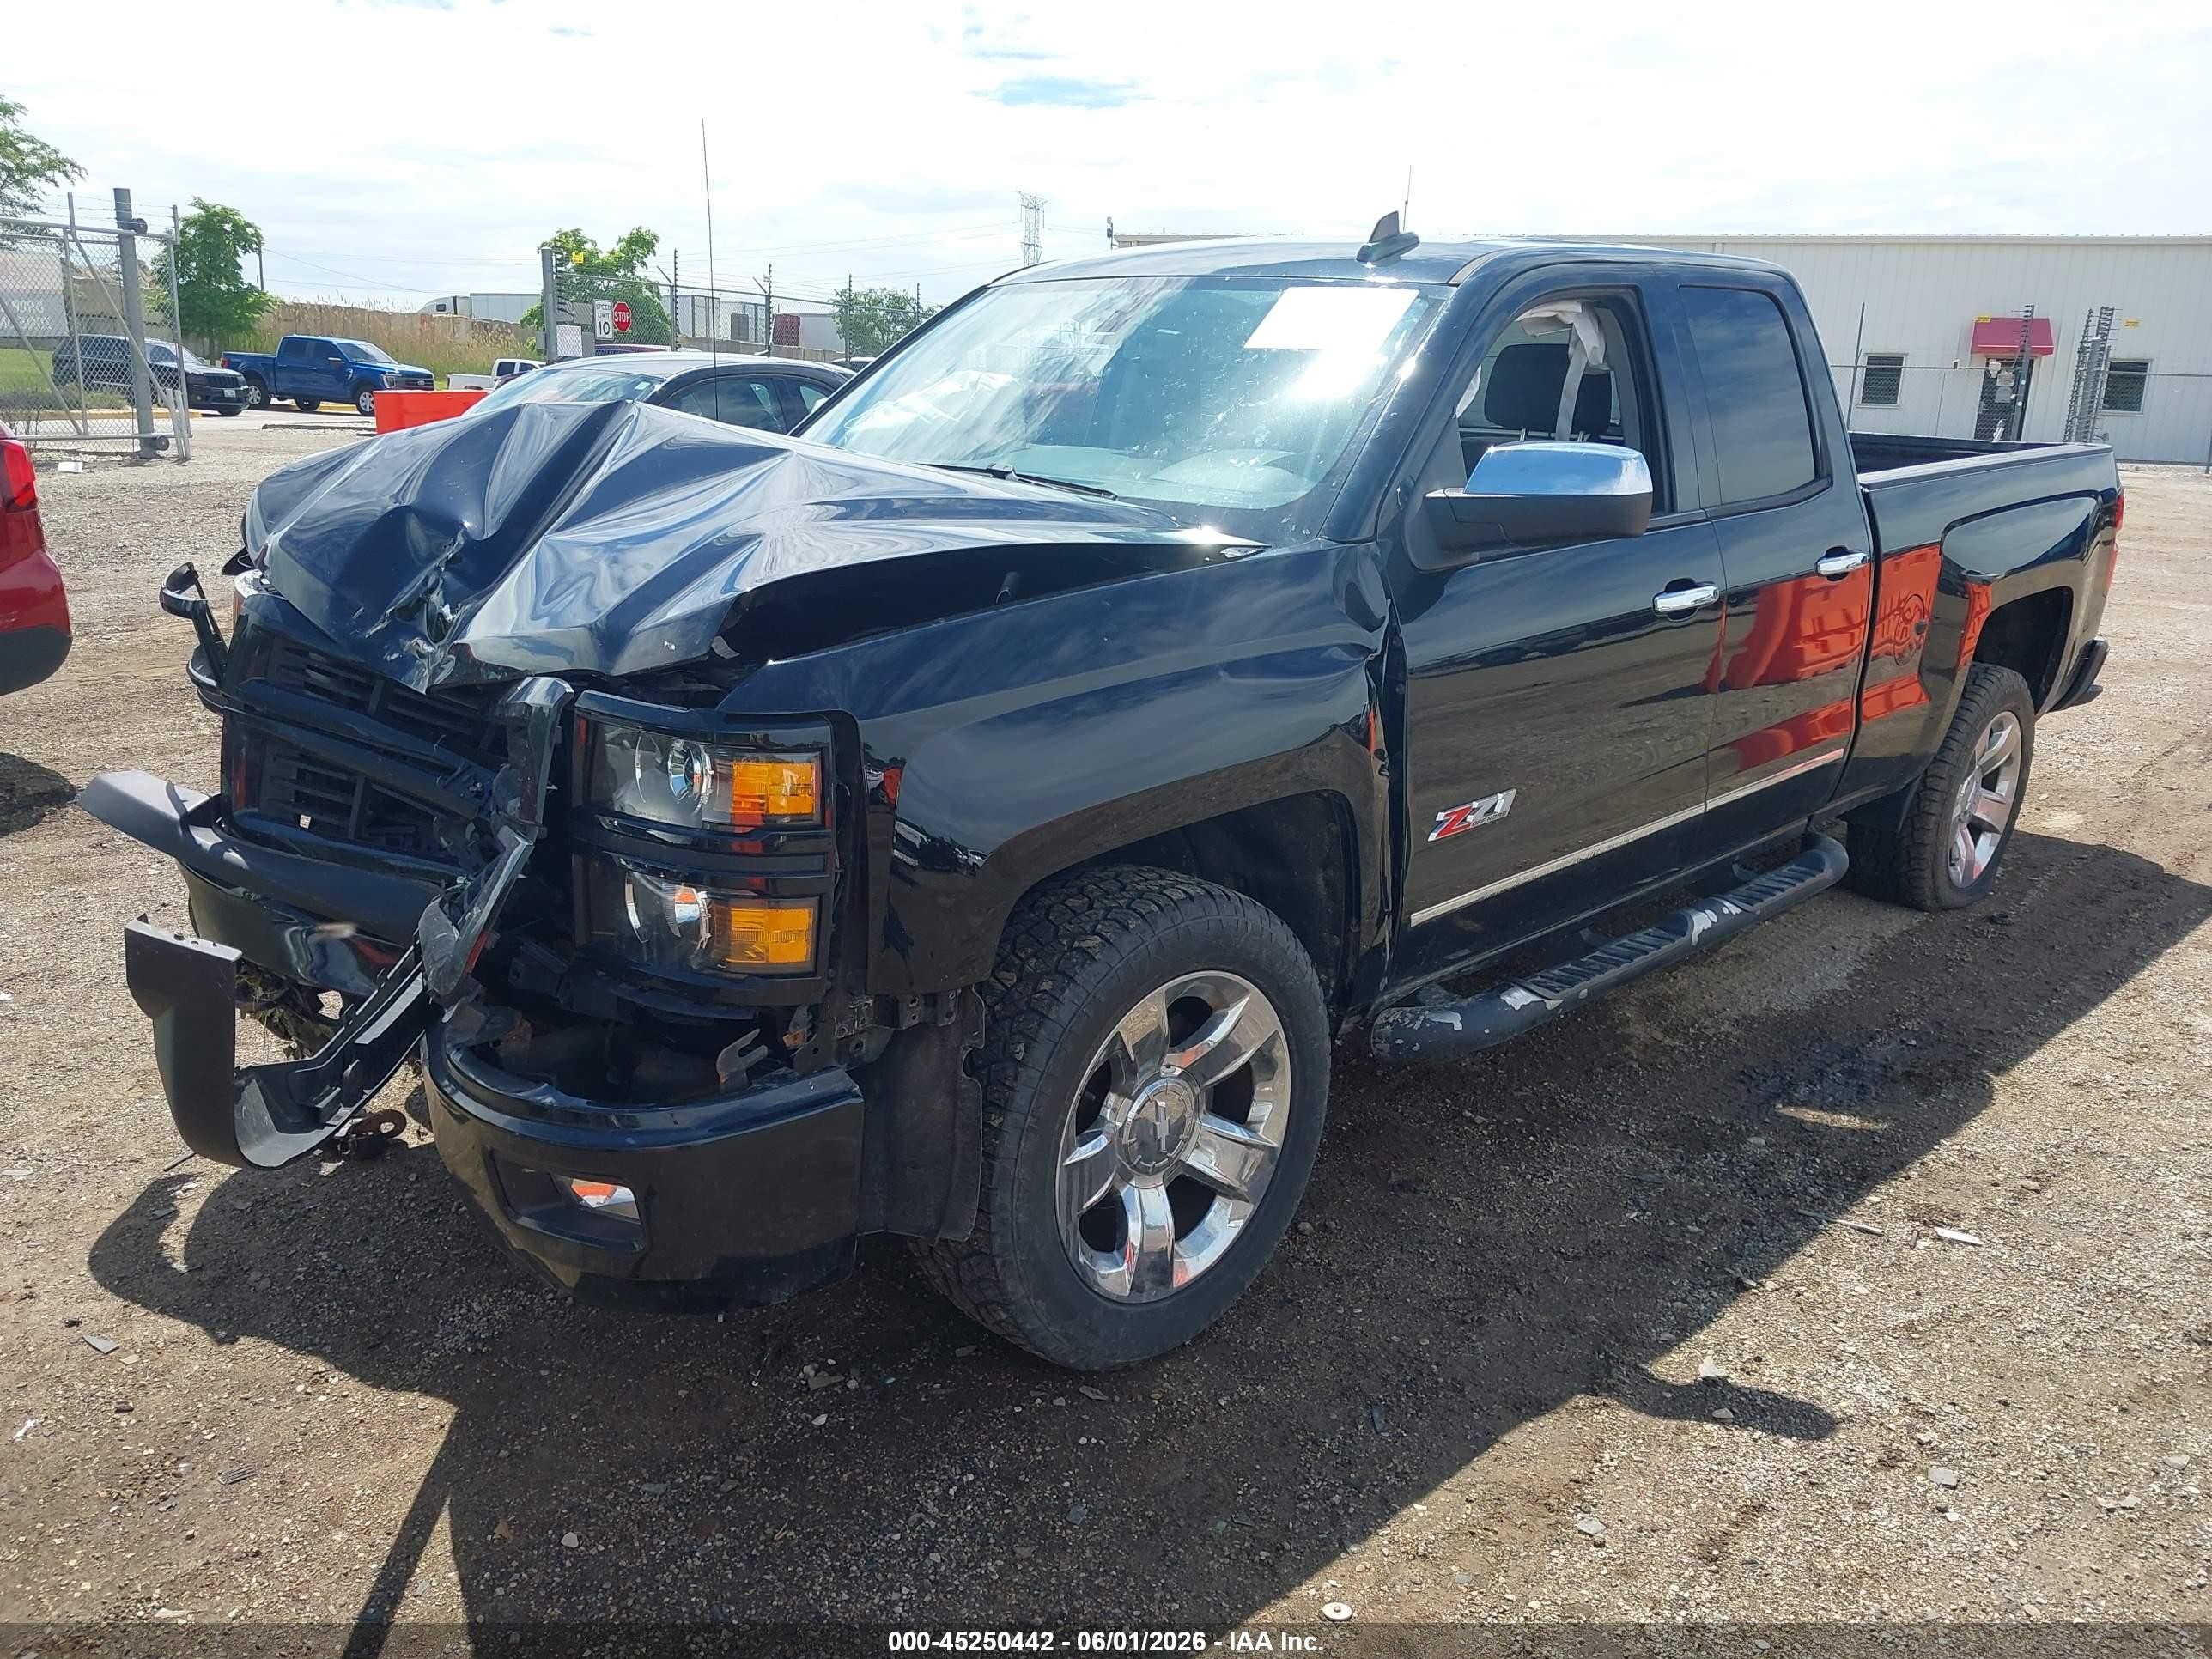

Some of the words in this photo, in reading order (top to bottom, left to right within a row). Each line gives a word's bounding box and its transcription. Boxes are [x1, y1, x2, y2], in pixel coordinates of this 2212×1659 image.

[614, 311, 630, 323] STOP
[598, 321, 611, 335] 10
[1427, 788, 1516, 842] Z71
